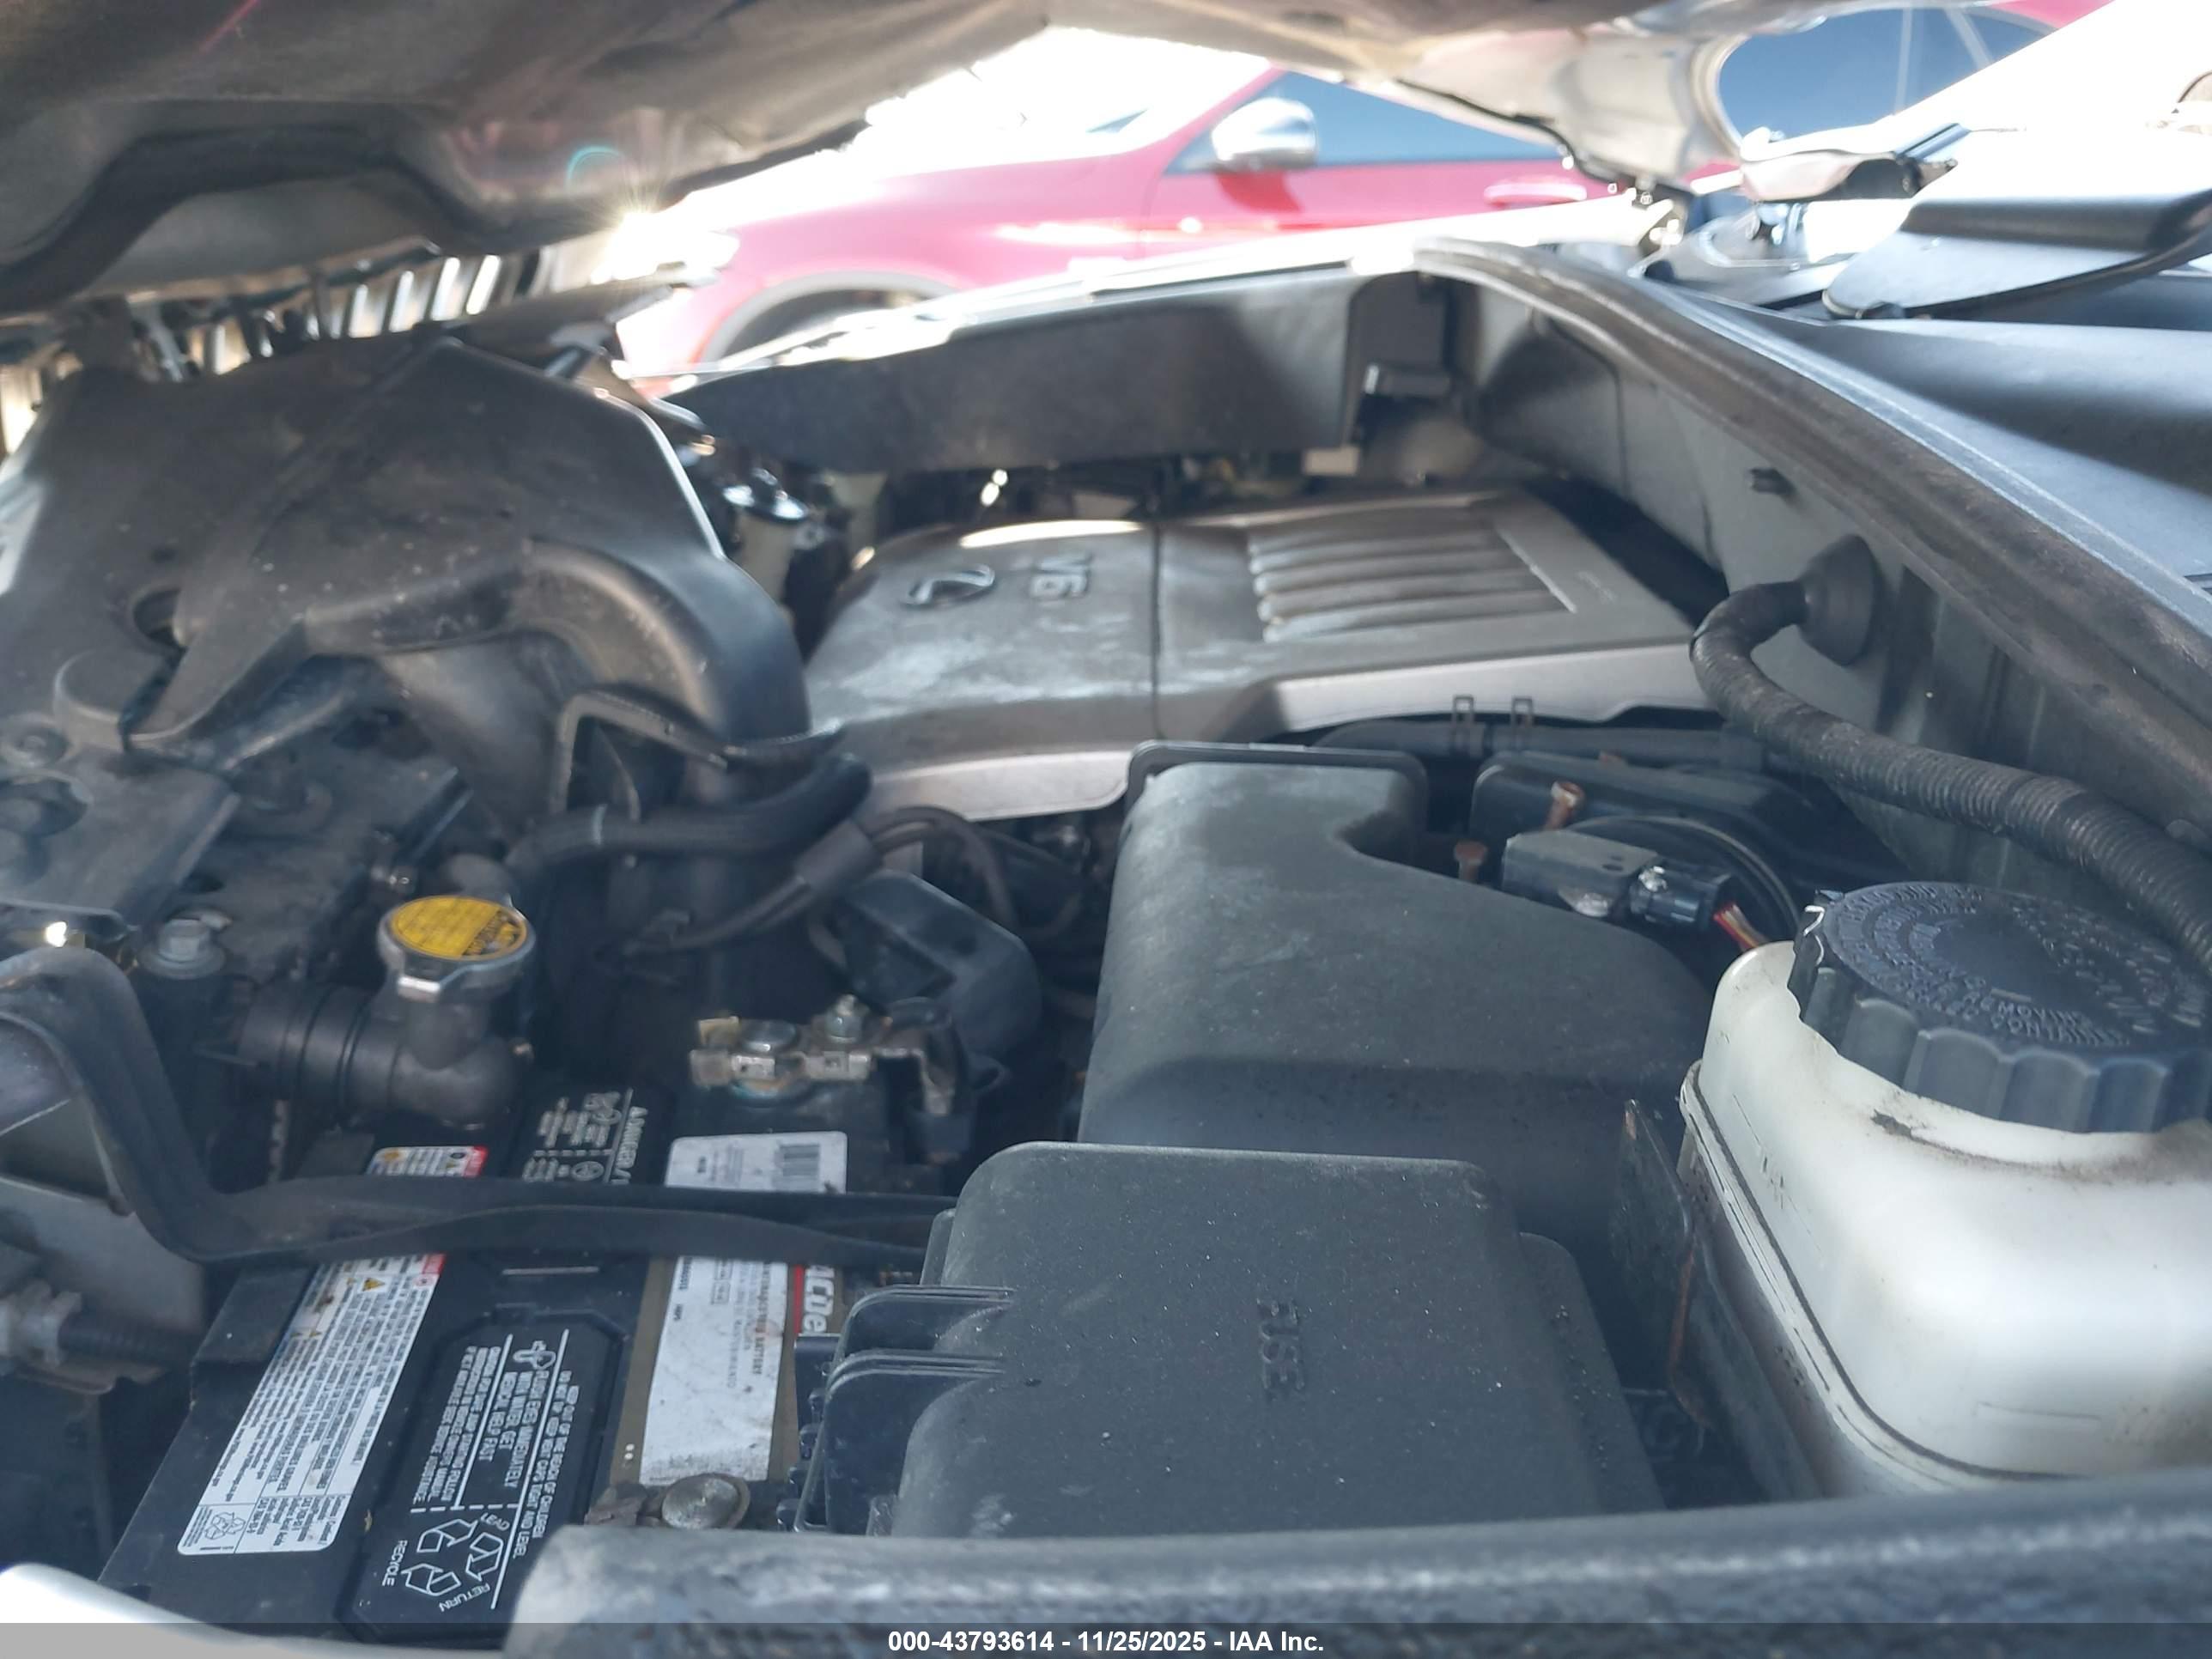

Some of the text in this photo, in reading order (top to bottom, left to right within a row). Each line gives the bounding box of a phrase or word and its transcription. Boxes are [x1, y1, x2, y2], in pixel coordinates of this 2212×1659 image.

[514, 1371, 533, 1395] WITH
[477, 1371, 518, 1462] MEDICAL HELP FAST
[560, 1405, 575, 1422] OUT
[497, 1431, 517, 1449] GET
[502, 1370, 550, 1487] FLUSH EYES IMMEDIATELY
[556, 1423, 571, 1436] OF
[538, 1438, 555, 1458] VENT
[552, 1436, 568, 1452] THE
[532, 1459, 549, 1482] CAPS
[545, 1453, 563, 1480] REACH
[525, 1484, 543, 1508] TIGHT
[542, 1482, 556, 1494] OF
[480, 1512, 510, 1531] LEAD
[520, 1510, 536, 1528] AND
[531, 1495, 553, 1538] CHILDREN
[382, 1540, 408, 1586] RECYCLE
[439, 1583, 491, 1612] RETURN
